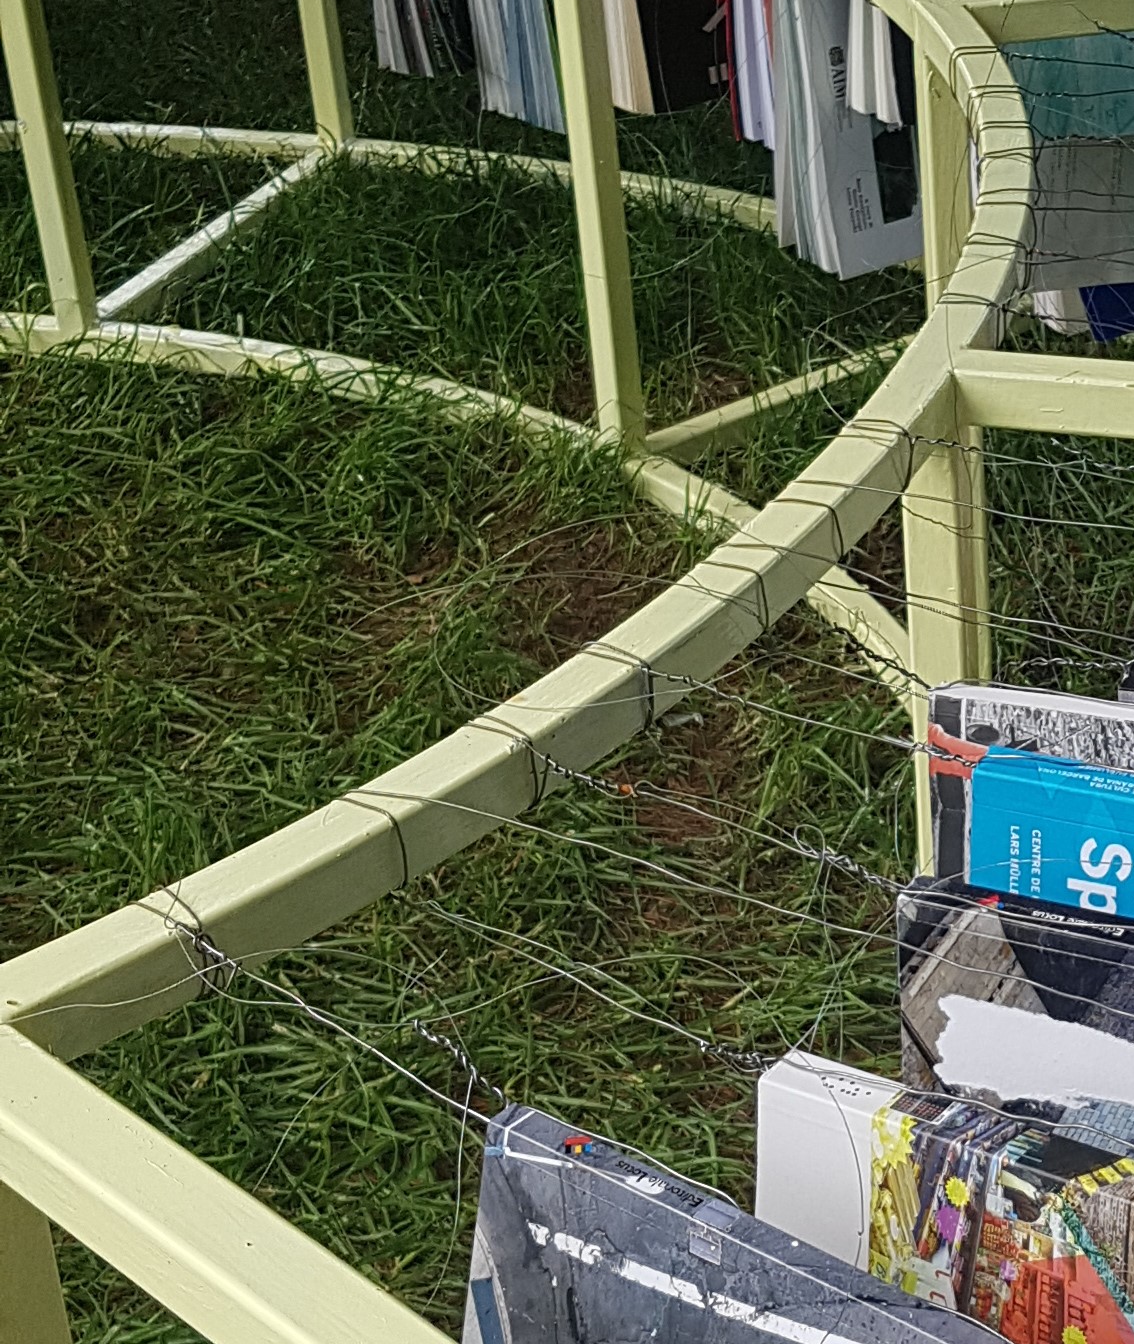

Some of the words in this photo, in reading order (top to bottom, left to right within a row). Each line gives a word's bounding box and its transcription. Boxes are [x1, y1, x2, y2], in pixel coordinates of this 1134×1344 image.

[1035, 765, 1091, 780] BARCELONA
[1092, 774, 1104, 782] DE
[1087, 780, 1130, 792] CULTURA
[1009, 825, 1019, 856] LARS
[1030, 829, 1041, 875] CENTRE
[1029, 877, 1040, 893] DE
[611, 1156, 648, 1184] Lotus
[645, 1173, 704, 1210] Editoriale
